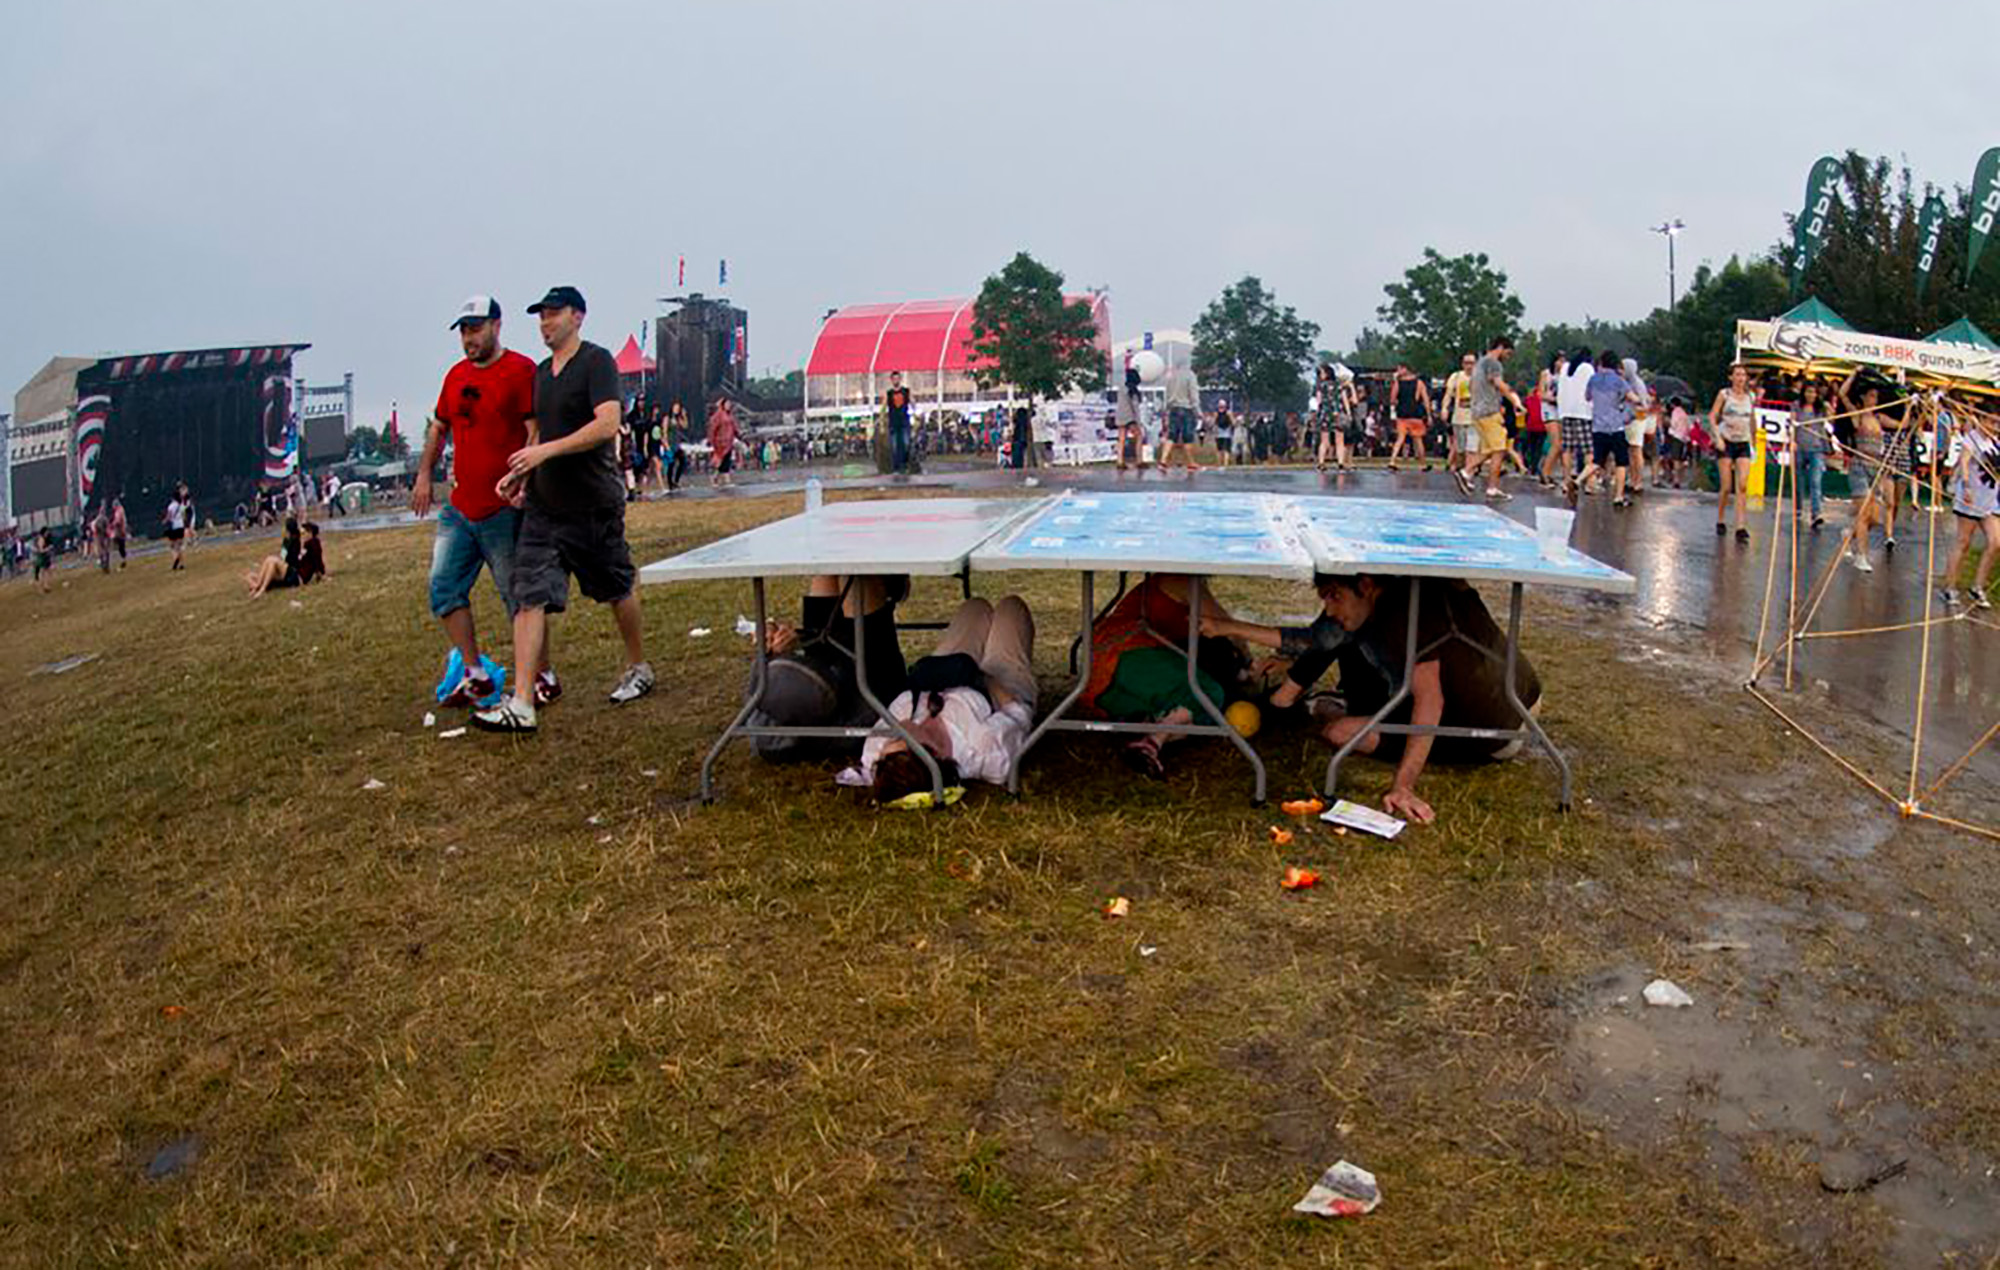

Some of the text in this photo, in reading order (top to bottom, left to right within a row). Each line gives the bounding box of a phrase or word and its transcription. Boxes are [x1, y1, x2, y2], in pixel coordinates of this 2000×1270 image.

[1844, 341, 1880, 358] zona
[1883, 344, 1916, 362] BBK
[1918, 350, 1965, 371] gunea
